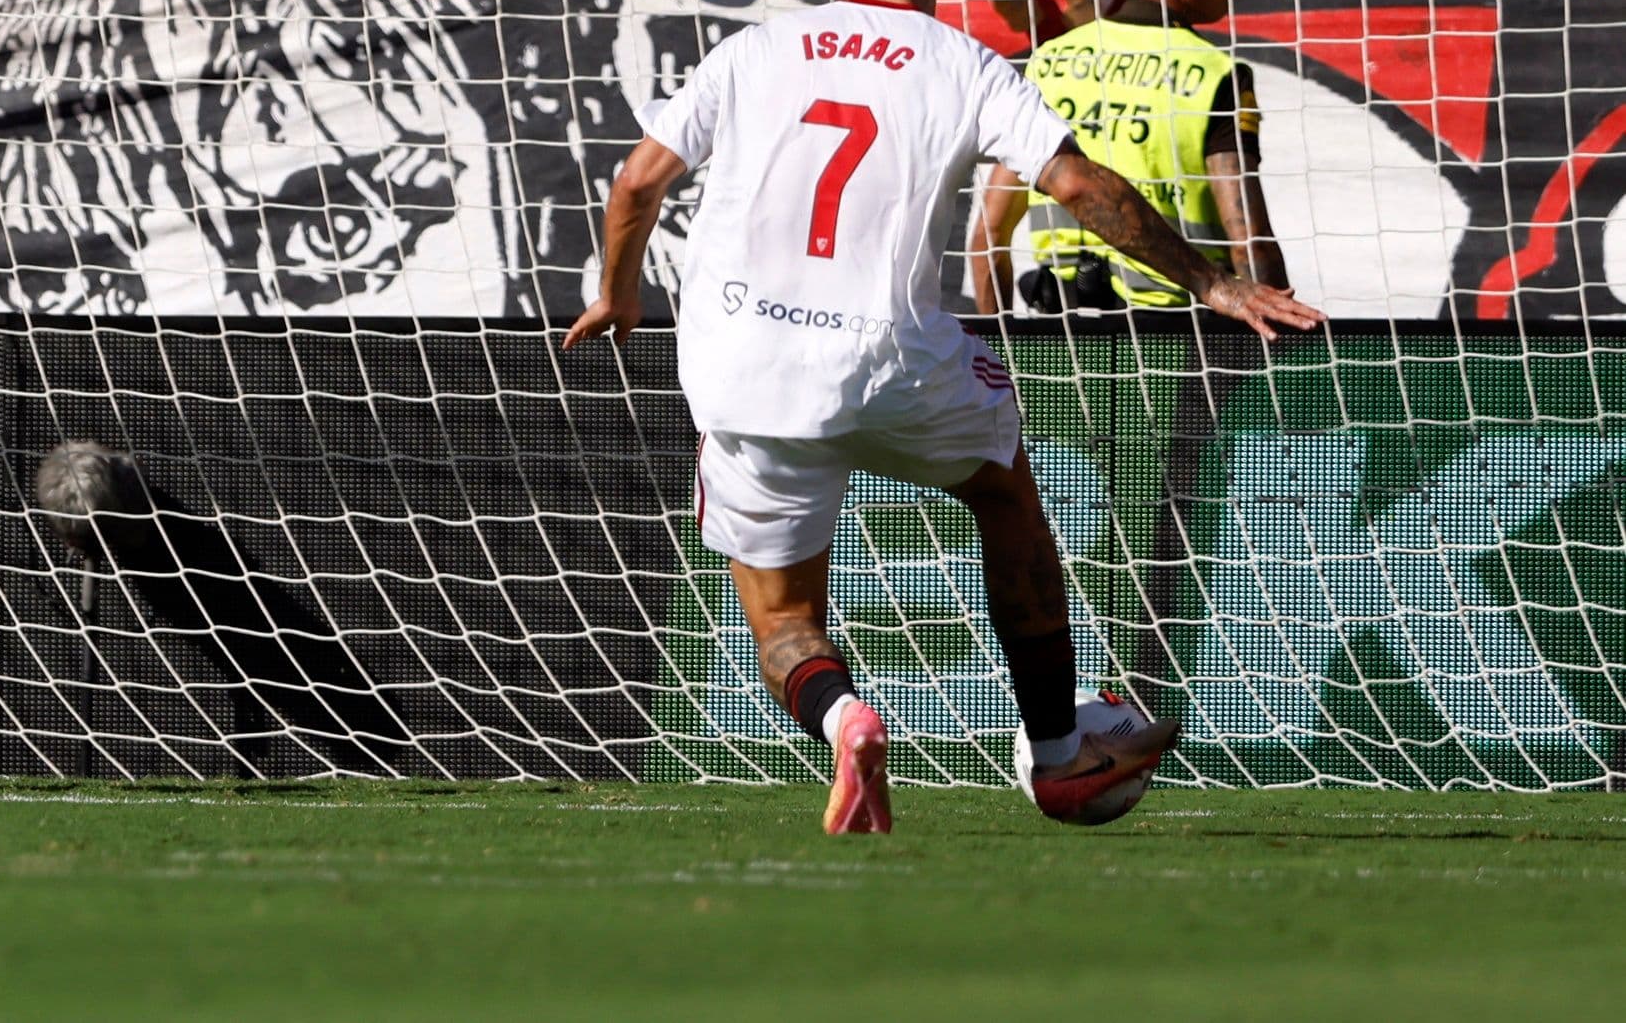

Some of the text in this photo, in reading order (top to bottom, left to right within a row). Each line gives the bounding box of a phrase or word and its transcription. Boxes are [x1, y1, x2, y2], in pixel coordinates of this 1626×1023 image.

[801, 30, 915, 72] ISAAC
[1037, 45, 1206, 97] SEGURIDAD
[800, 98, 879, 260] 7
